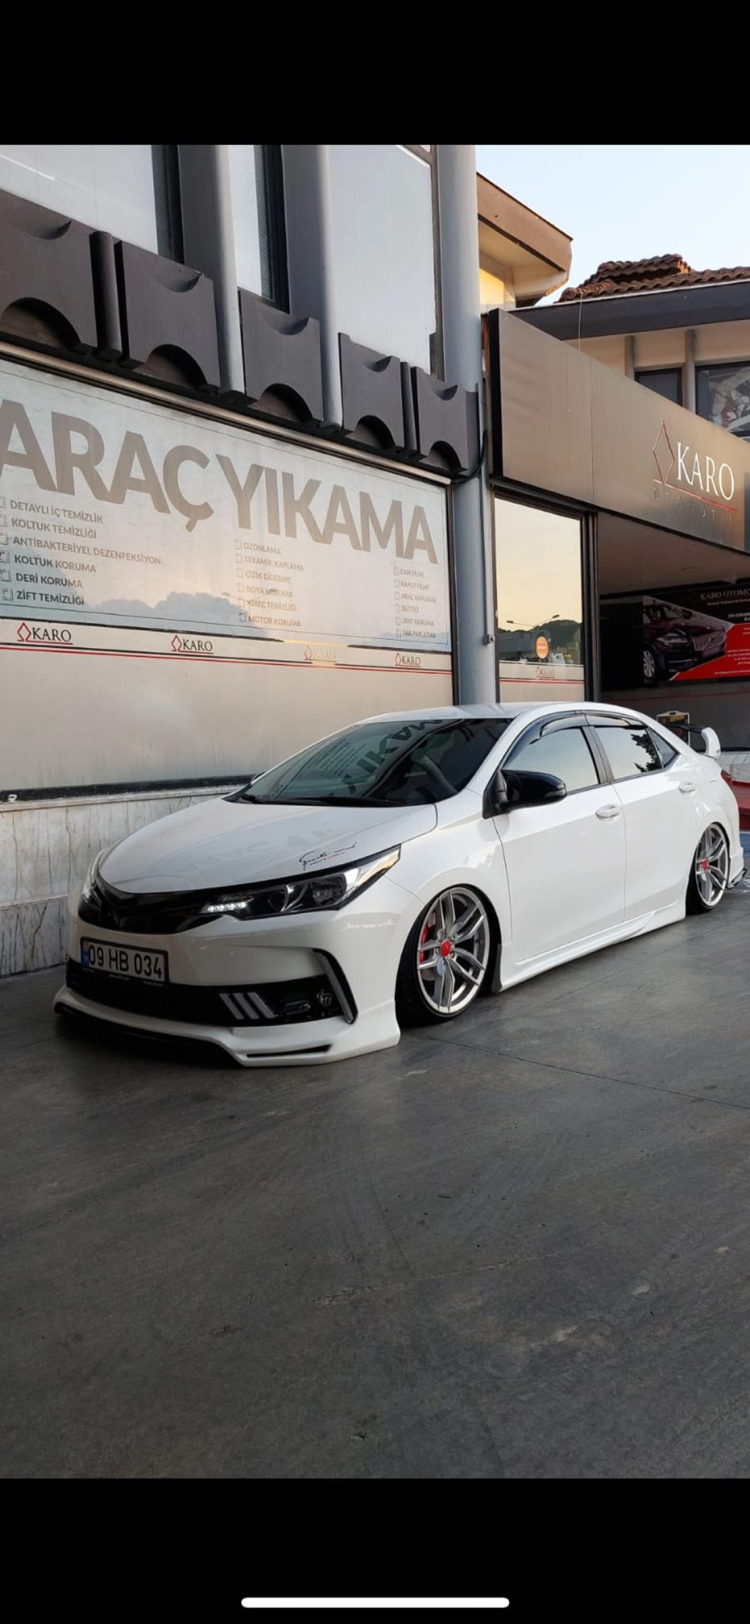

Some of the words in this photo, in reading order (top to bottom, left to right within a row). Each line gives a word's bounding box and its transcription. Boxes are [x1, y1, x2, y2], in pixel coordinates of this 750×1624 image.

[677, 442, 734, 500] KARO
[0, 399, 214, 532] ARAÇ
[215, 453, 438, 565] YIKAMA
[10, 500, 49, 515] DETAYLI
[51, 506, 60, 517] İÇ
[62, 509, 103, 524] TEMİZLİK
[12, 518, 50, 532] KOLTUK
[52, 524, 97, 539] TEMİZLİĞİ
[13, 536, 94, 556] ANTİBAKTERİYEL
[94, 548, 161, 565] DEZENFEKSİYON
[14, 554, 53, 568] KOLTUK
[55, 560, 97, 573] KORUMA
[16, 572, 38, 583] DERİ
[41, 576, 83, 589] KORUMA
[17, 590, 37, 601] ZİFT
[39, 593, 84, 606] TEMİZLİĞİ
[700, 591, 722, 600] KARO
[32, 627, 72, 642] KARO
[183, 639, 213, 651] KARO
[402, 655, 421, 666] KARO
[88, 945, 104, 967] 09
[108, 948, 129, 972] HB
[134, 953, 162, 979] 034
